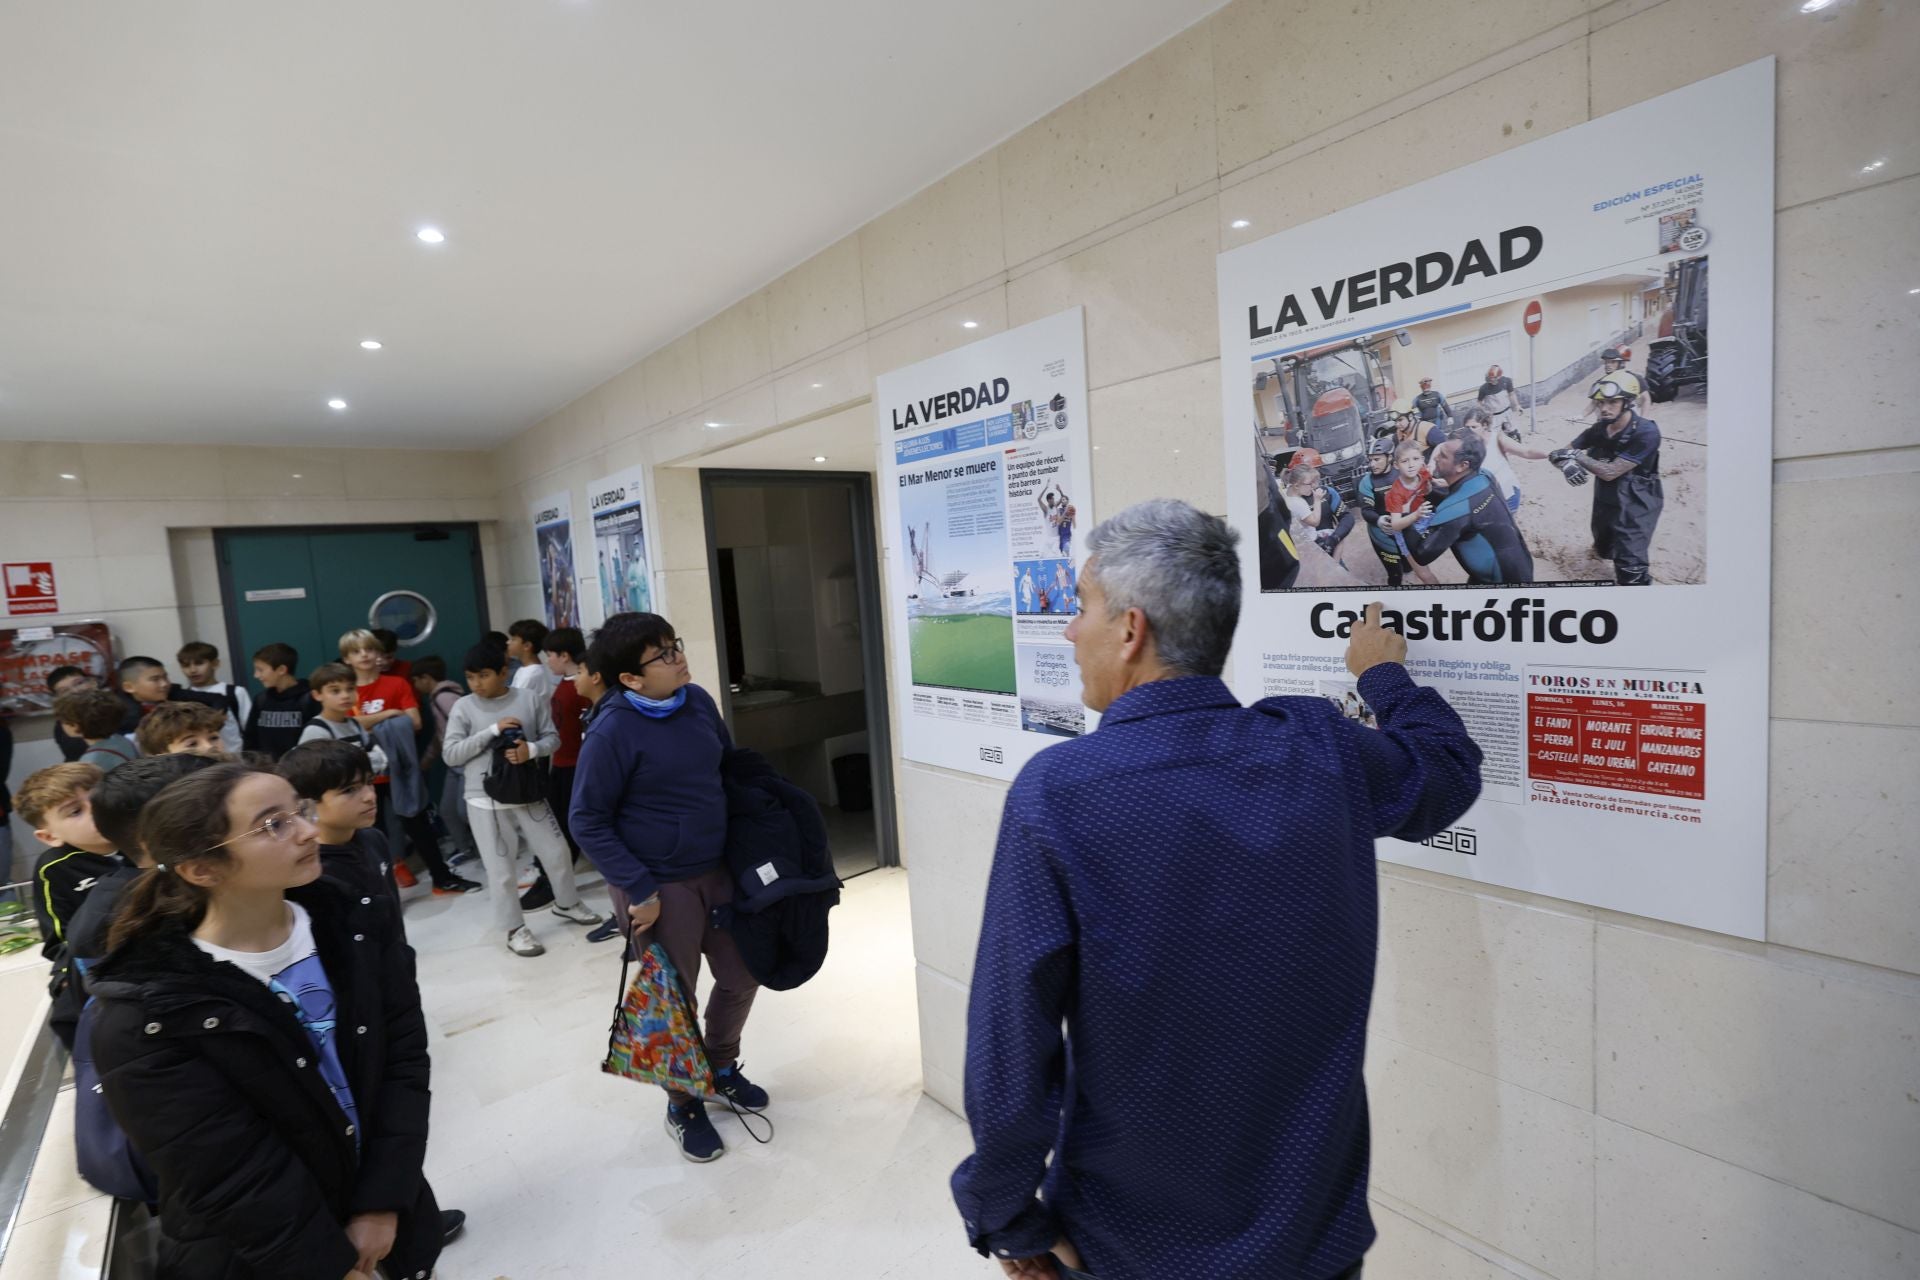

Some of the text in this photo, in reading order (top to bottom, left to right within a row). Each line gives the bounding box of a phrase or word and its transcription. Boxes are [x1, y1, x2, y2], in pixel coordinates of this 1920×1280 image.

[1592, 174, 1703, 212] EDICIÓN ESPECIAL
[1249, 225, 1543, 339] LA VERDAD
[893, 404, 918, 431] LA
[919, 377, 1010, 424] VERDAD
[1008, 463, 1015, 471] Un
[1016, 460, 1034, 471] equipo
[1036, 458, 1043, 466] de
[899, 459, 996, 487] El Mar Menor se muere
[1012, 470, 1028, 480] punto
[1038, 466, 1059, 475] tumbar
[1021, 479, 1041, 487] barrera
[591, 488, 625, 509] LA VERDAD
[1009, 489, 1032, 498] histórica
[535, 508, 559, 524] LA VERDAD
[1302, 655, 1331, 663] provoca
[1428, 659, 1436, 668] la
[1440, 660, 1470, 670] Región
[1480, 662, 1510, 672] obliga
[1434, 669, 1442, 678] el
[1464, 670, 1478, 680] las
[1479, 672, 1519, 682] ramblas
[1529, 674, 1704, 694] TOROS EN MURCIA
[1592, 699, 1615, 707] LUNES,
[1535, 716, 1571, 729] EL FANDI
[1586, 721, 1632, 734] MORANTE
[1544, 733, 1573, 746] PERERA
[1640, 724, 1703, 740] ENRIQUE PONCE
[1592, 738, 1626, 751] EL JULI
[1641, 742, 1702, 759] MANZANARES
[1537, 750, 1578, 764] CASTELLA
[1582, 754, 1636, 770] PACO UREÑA
[1648, 761, 1696, 777] CAYETANO
[1531, 792, 1702, 824] plazadetorosdemurcia.com
[1562, 790, 1582, 798] Venta
[1583, 792, 1606, 801] Oficial
[1619, 796, 1651, 807] Entradas
[1653, 802, 1666, 810] por
